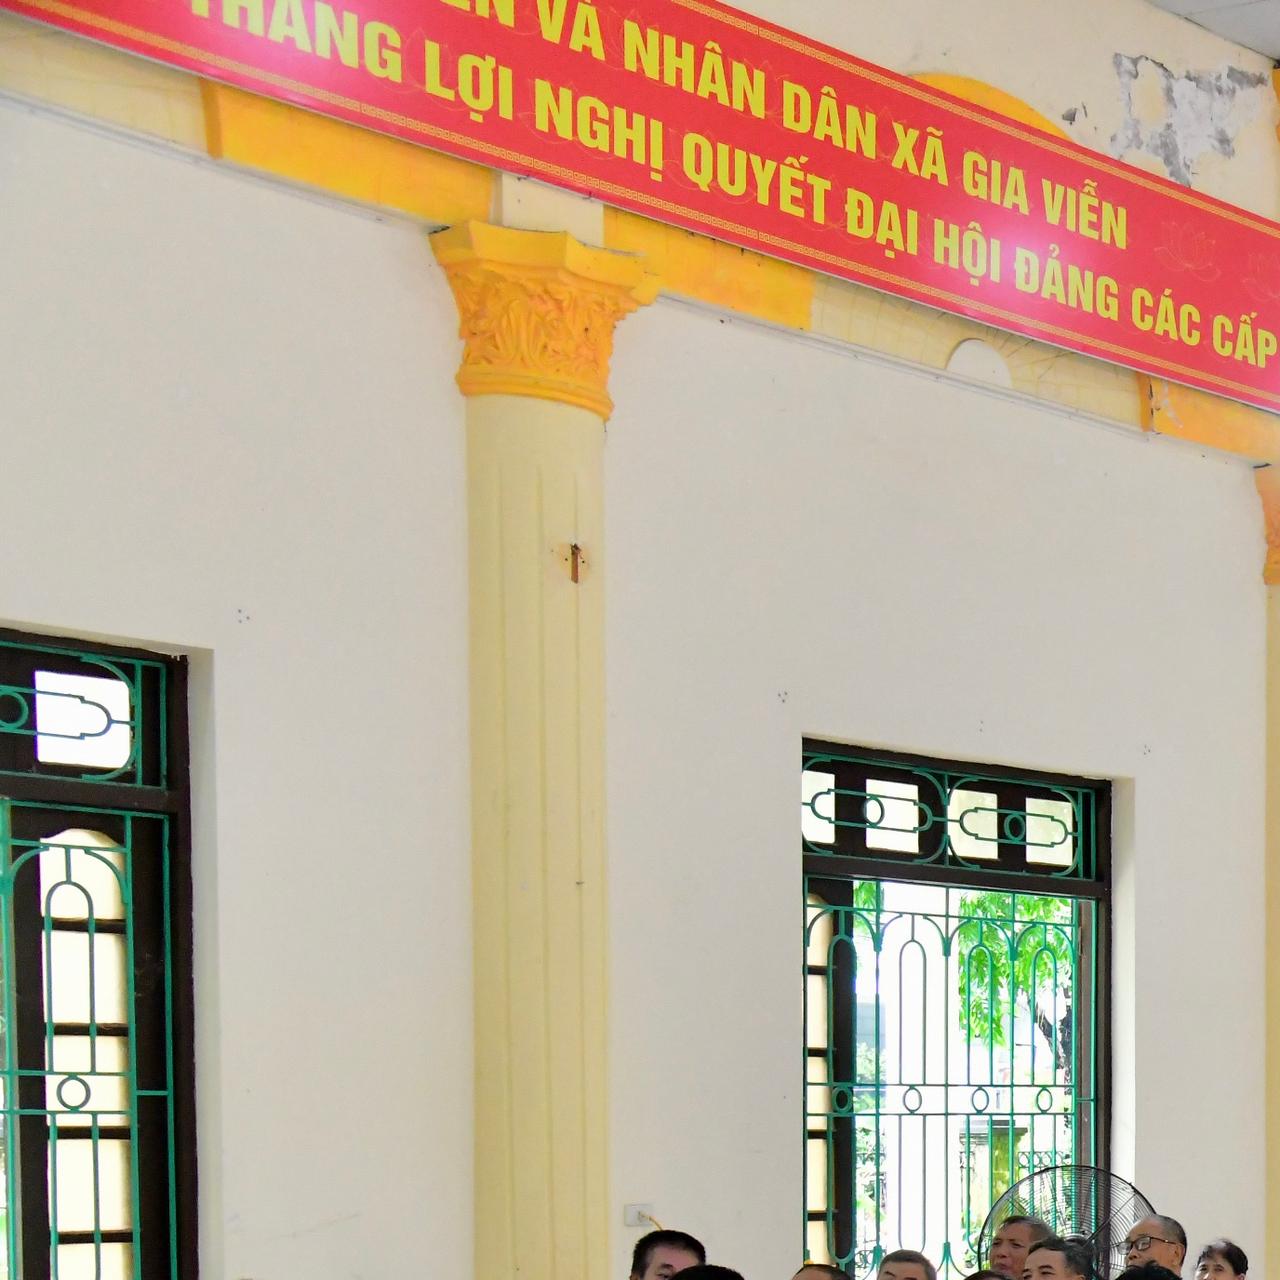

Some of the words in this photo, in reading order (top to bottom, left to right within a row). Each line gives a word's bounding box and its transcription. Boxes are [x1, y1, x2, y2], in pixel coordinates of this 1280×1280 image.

[192, 0, 402, 83] HNG
[424, 40, 513, 123] LỢI
[535, 79, 664, 181] NGHỊ
[683, 133, 831, 224] QUYẾT
[845, 188, 918, 258] ĐẠI
[934, 219, 1002, 286] HỘI
[1013, 244, 1118, 320] ĐẢNG
[1132, 288, 1200, 346] CÁC
[624, 19, 765, 119] NHÂN
[783, 80, 876, 159] DÂN
[892, 122, 948, 186] XÃ
[963, 151, 1029, 214] GIA
[1043, 179, 1126, 249] VIỄN
